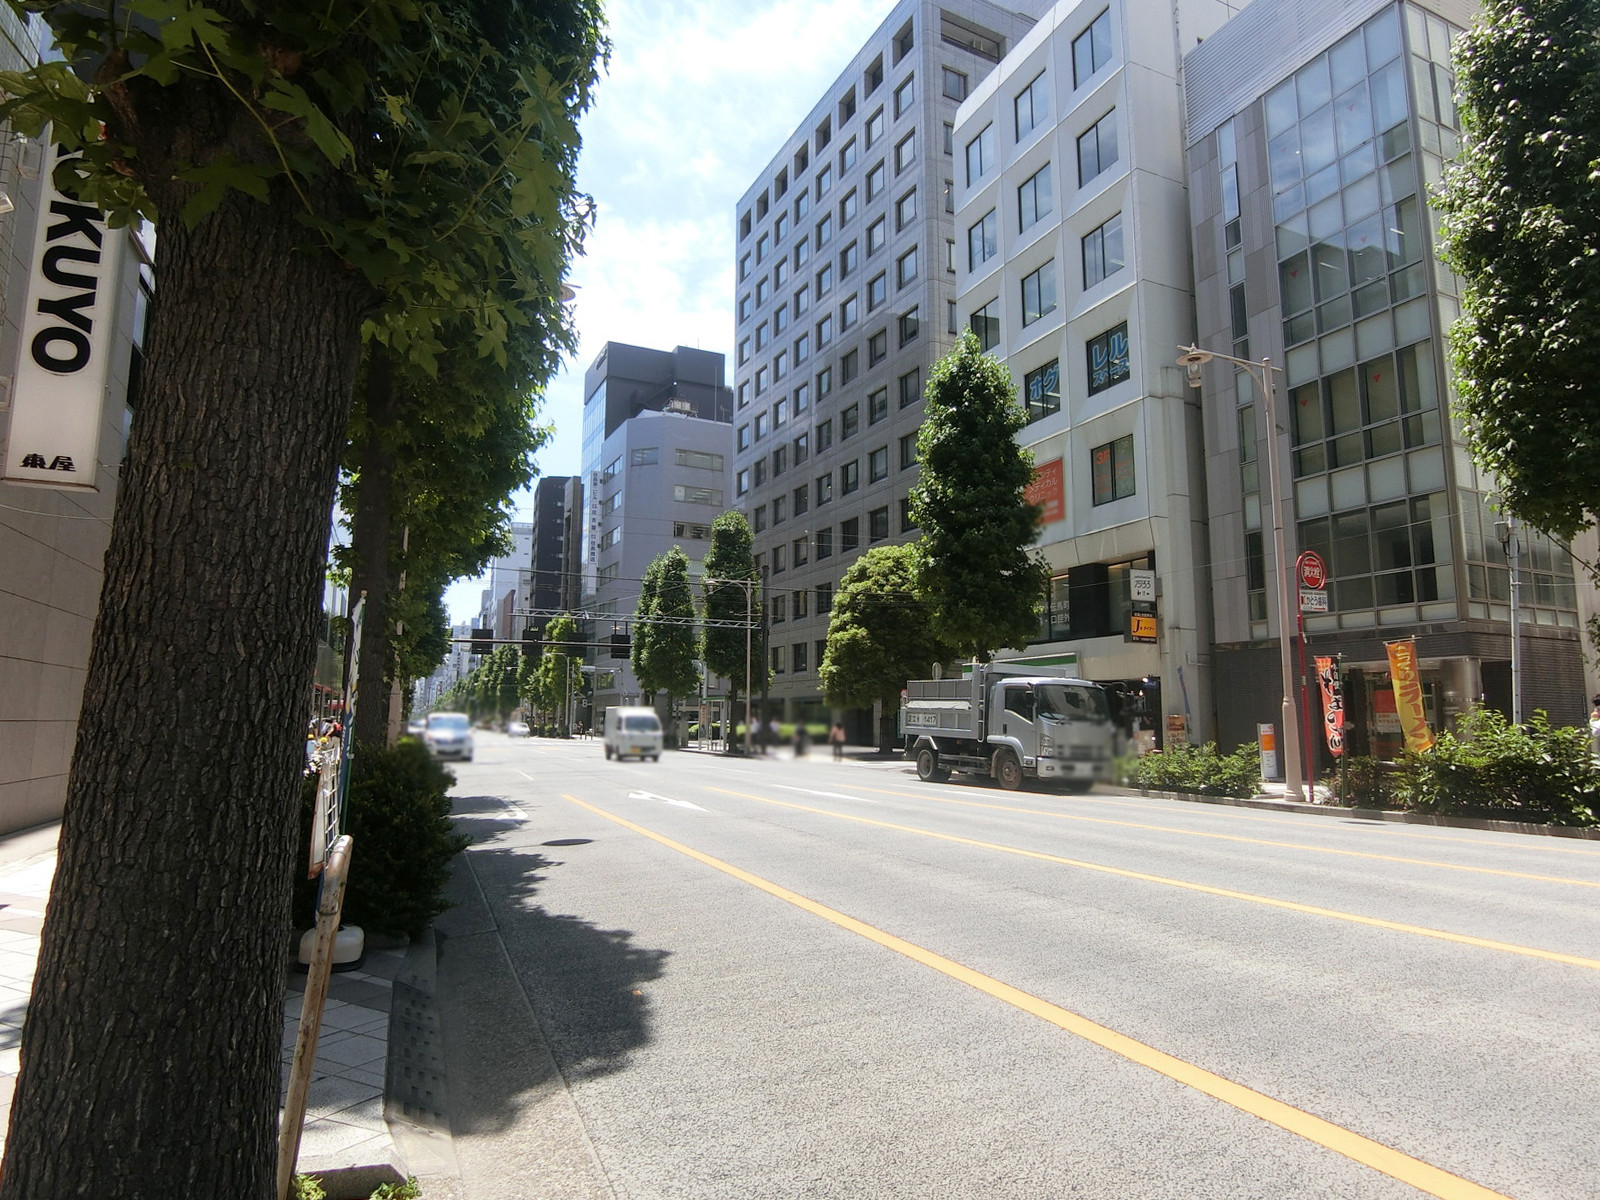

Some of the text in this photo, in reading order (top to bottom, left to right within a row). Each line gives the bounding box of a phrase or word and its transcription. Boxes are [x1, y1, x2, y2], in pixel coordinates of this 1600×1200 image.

[19, 453, 76, 472] 東屋
[1303, 565, 1320, 579] 消火栓
[924, 715, 936, 723] 1417
